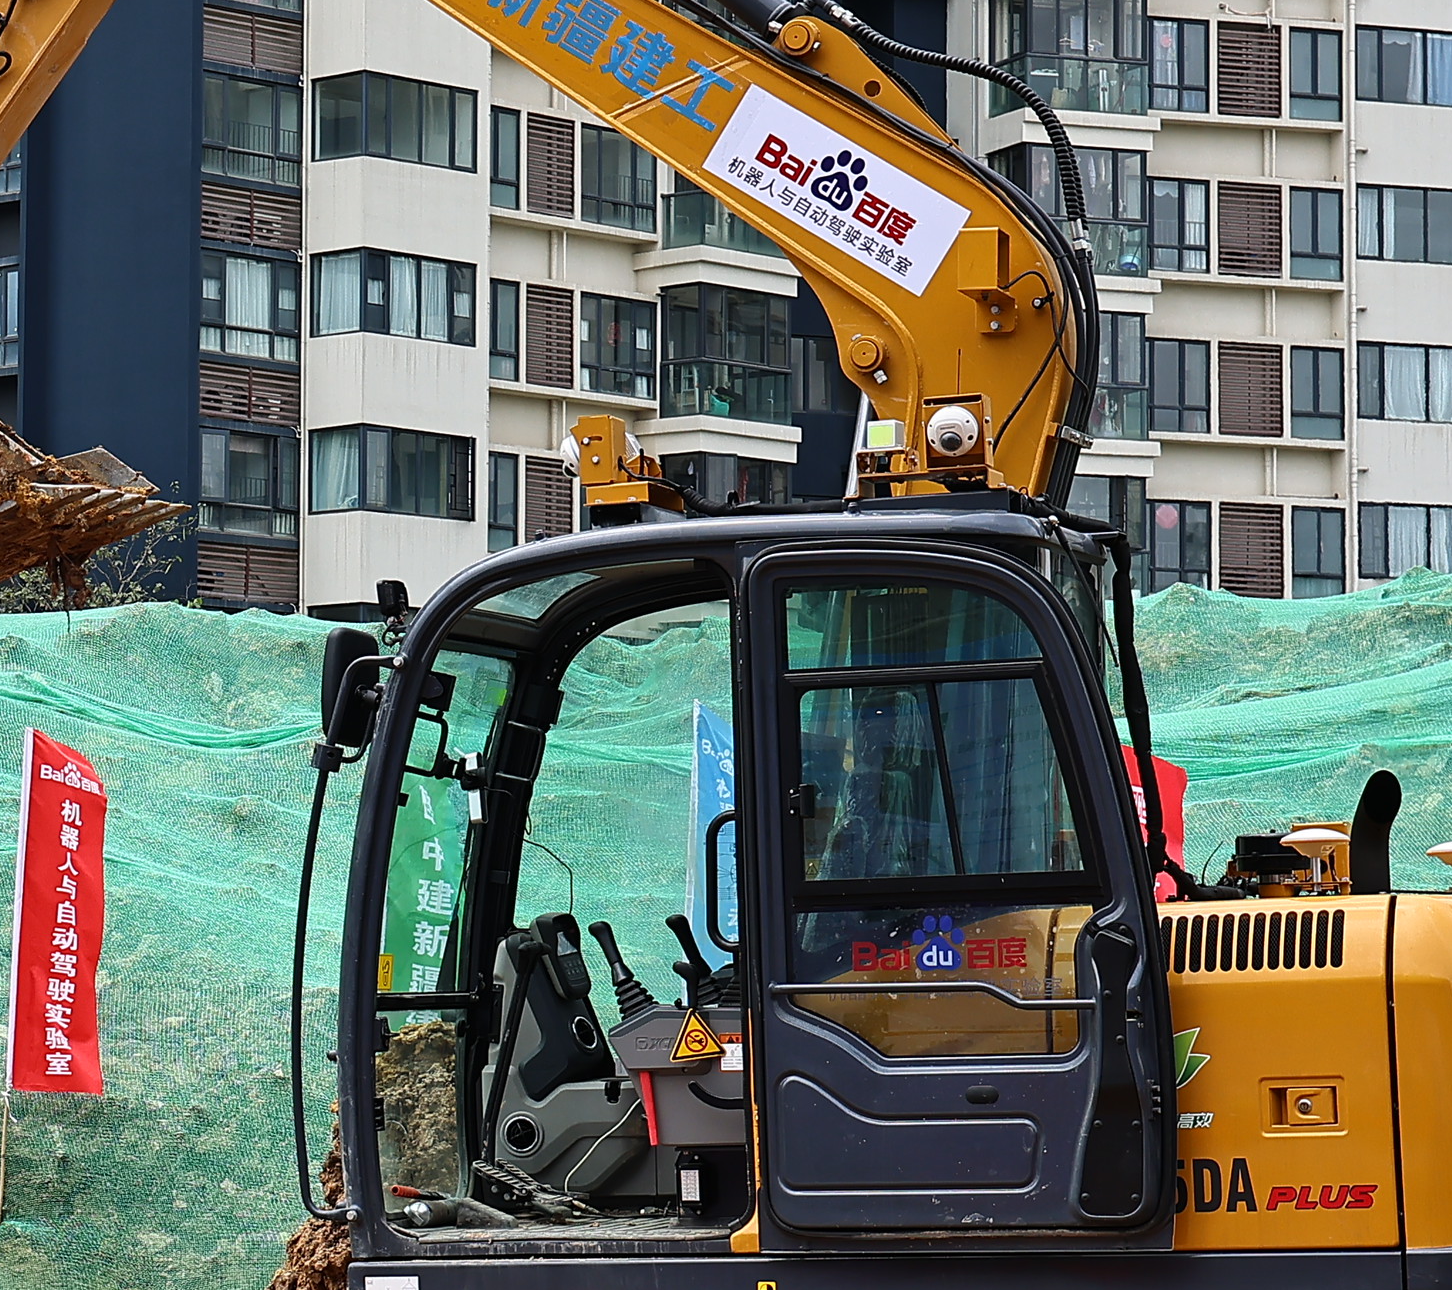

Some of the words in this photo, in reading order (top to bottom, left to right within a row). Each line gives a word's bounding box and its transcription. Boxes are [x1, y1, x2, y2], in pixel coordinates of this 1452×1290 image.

[727, 155, 914, 278] 机器人与自动驾驶实验室
[44, 799, 84, 1076] 机器人与自动驾驶实验室
[1265, 1184, 1379, 1211] PLUS
